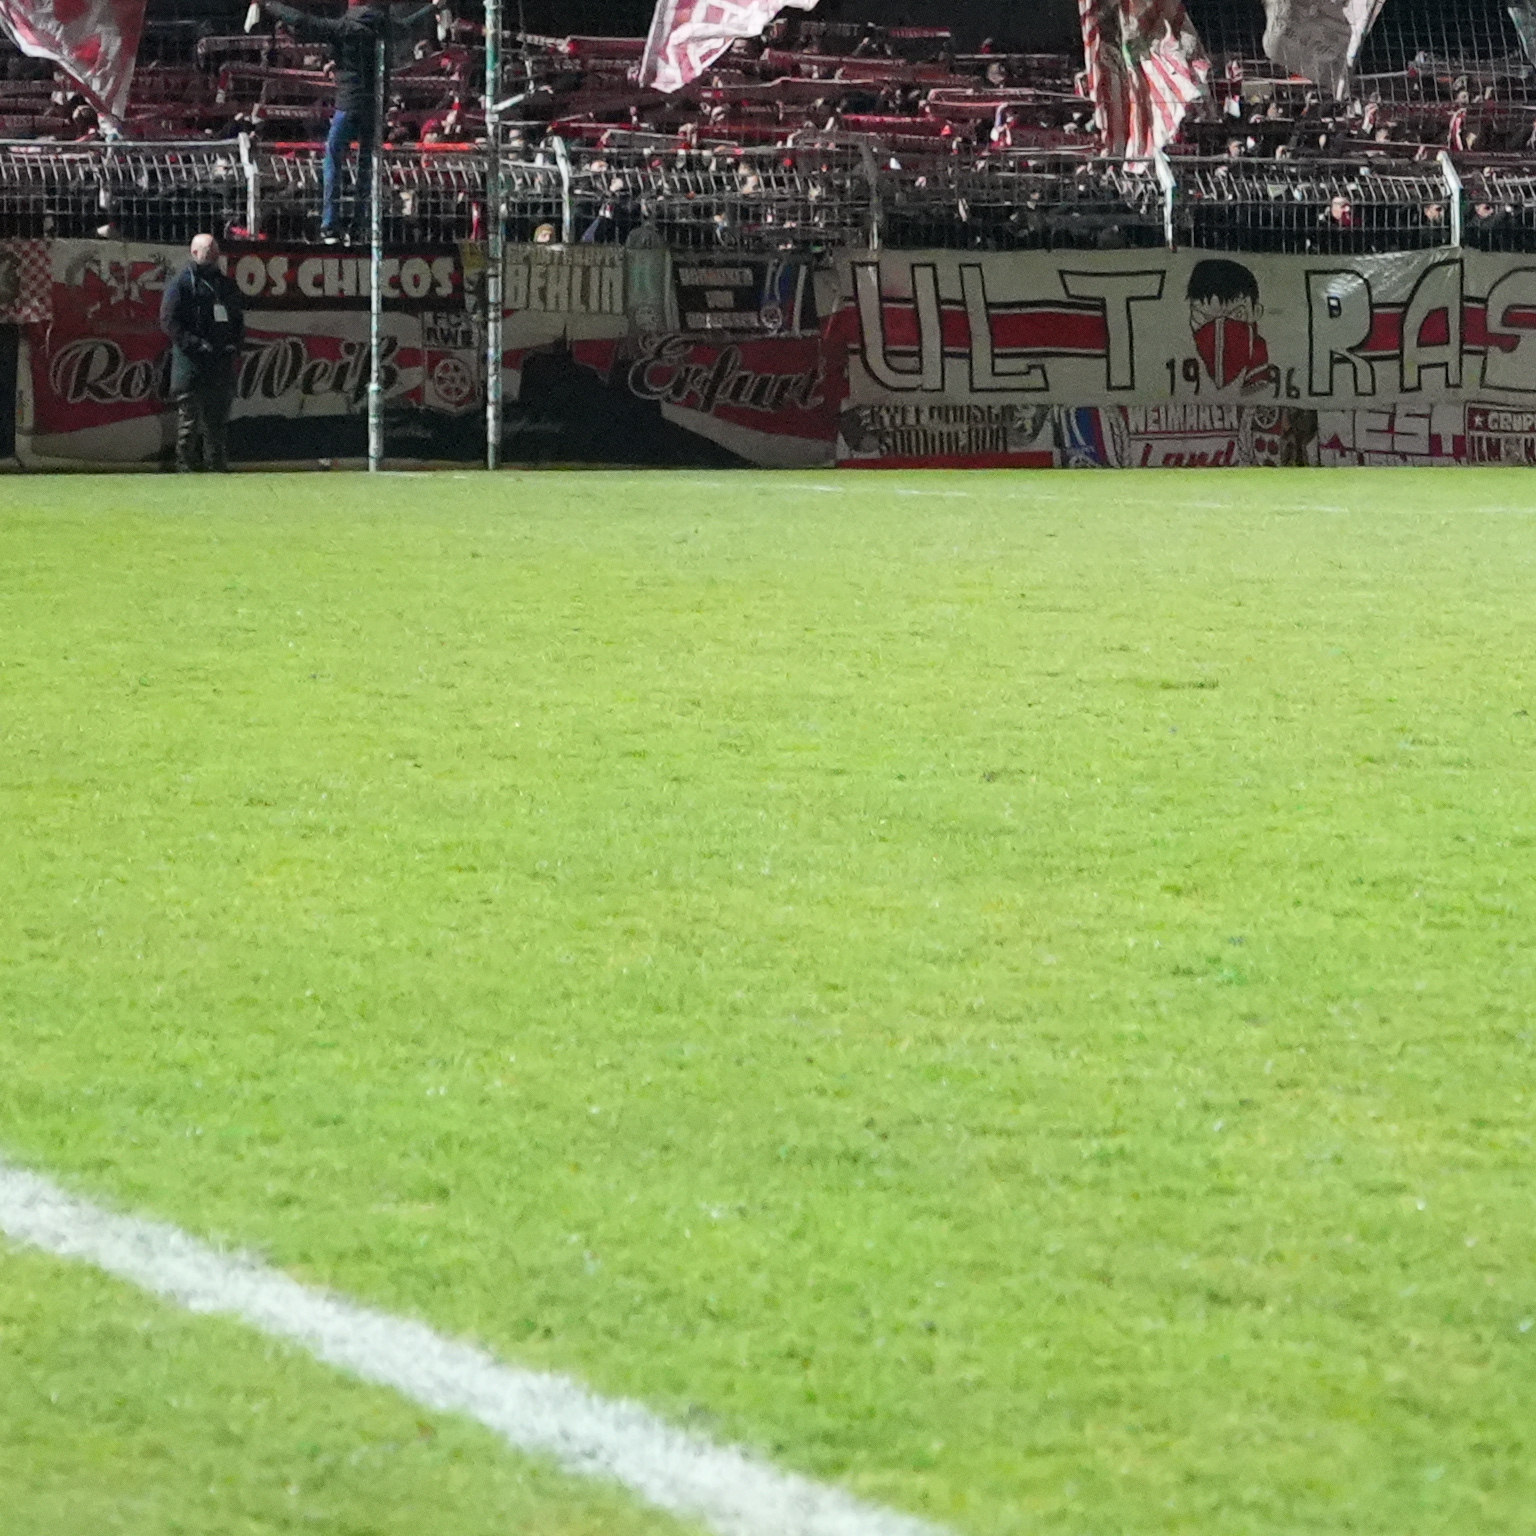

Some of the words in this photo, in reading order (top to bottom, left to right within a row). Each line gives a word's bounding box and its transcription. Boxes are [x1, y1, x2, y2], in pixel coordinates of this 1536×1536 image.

[298, 257, 454, 298] CHICOS
[628, 333, 824, 412] Erfurt
[1167, 358, 1201, 396] 19
[1267, 363, 1301, 399] 96
